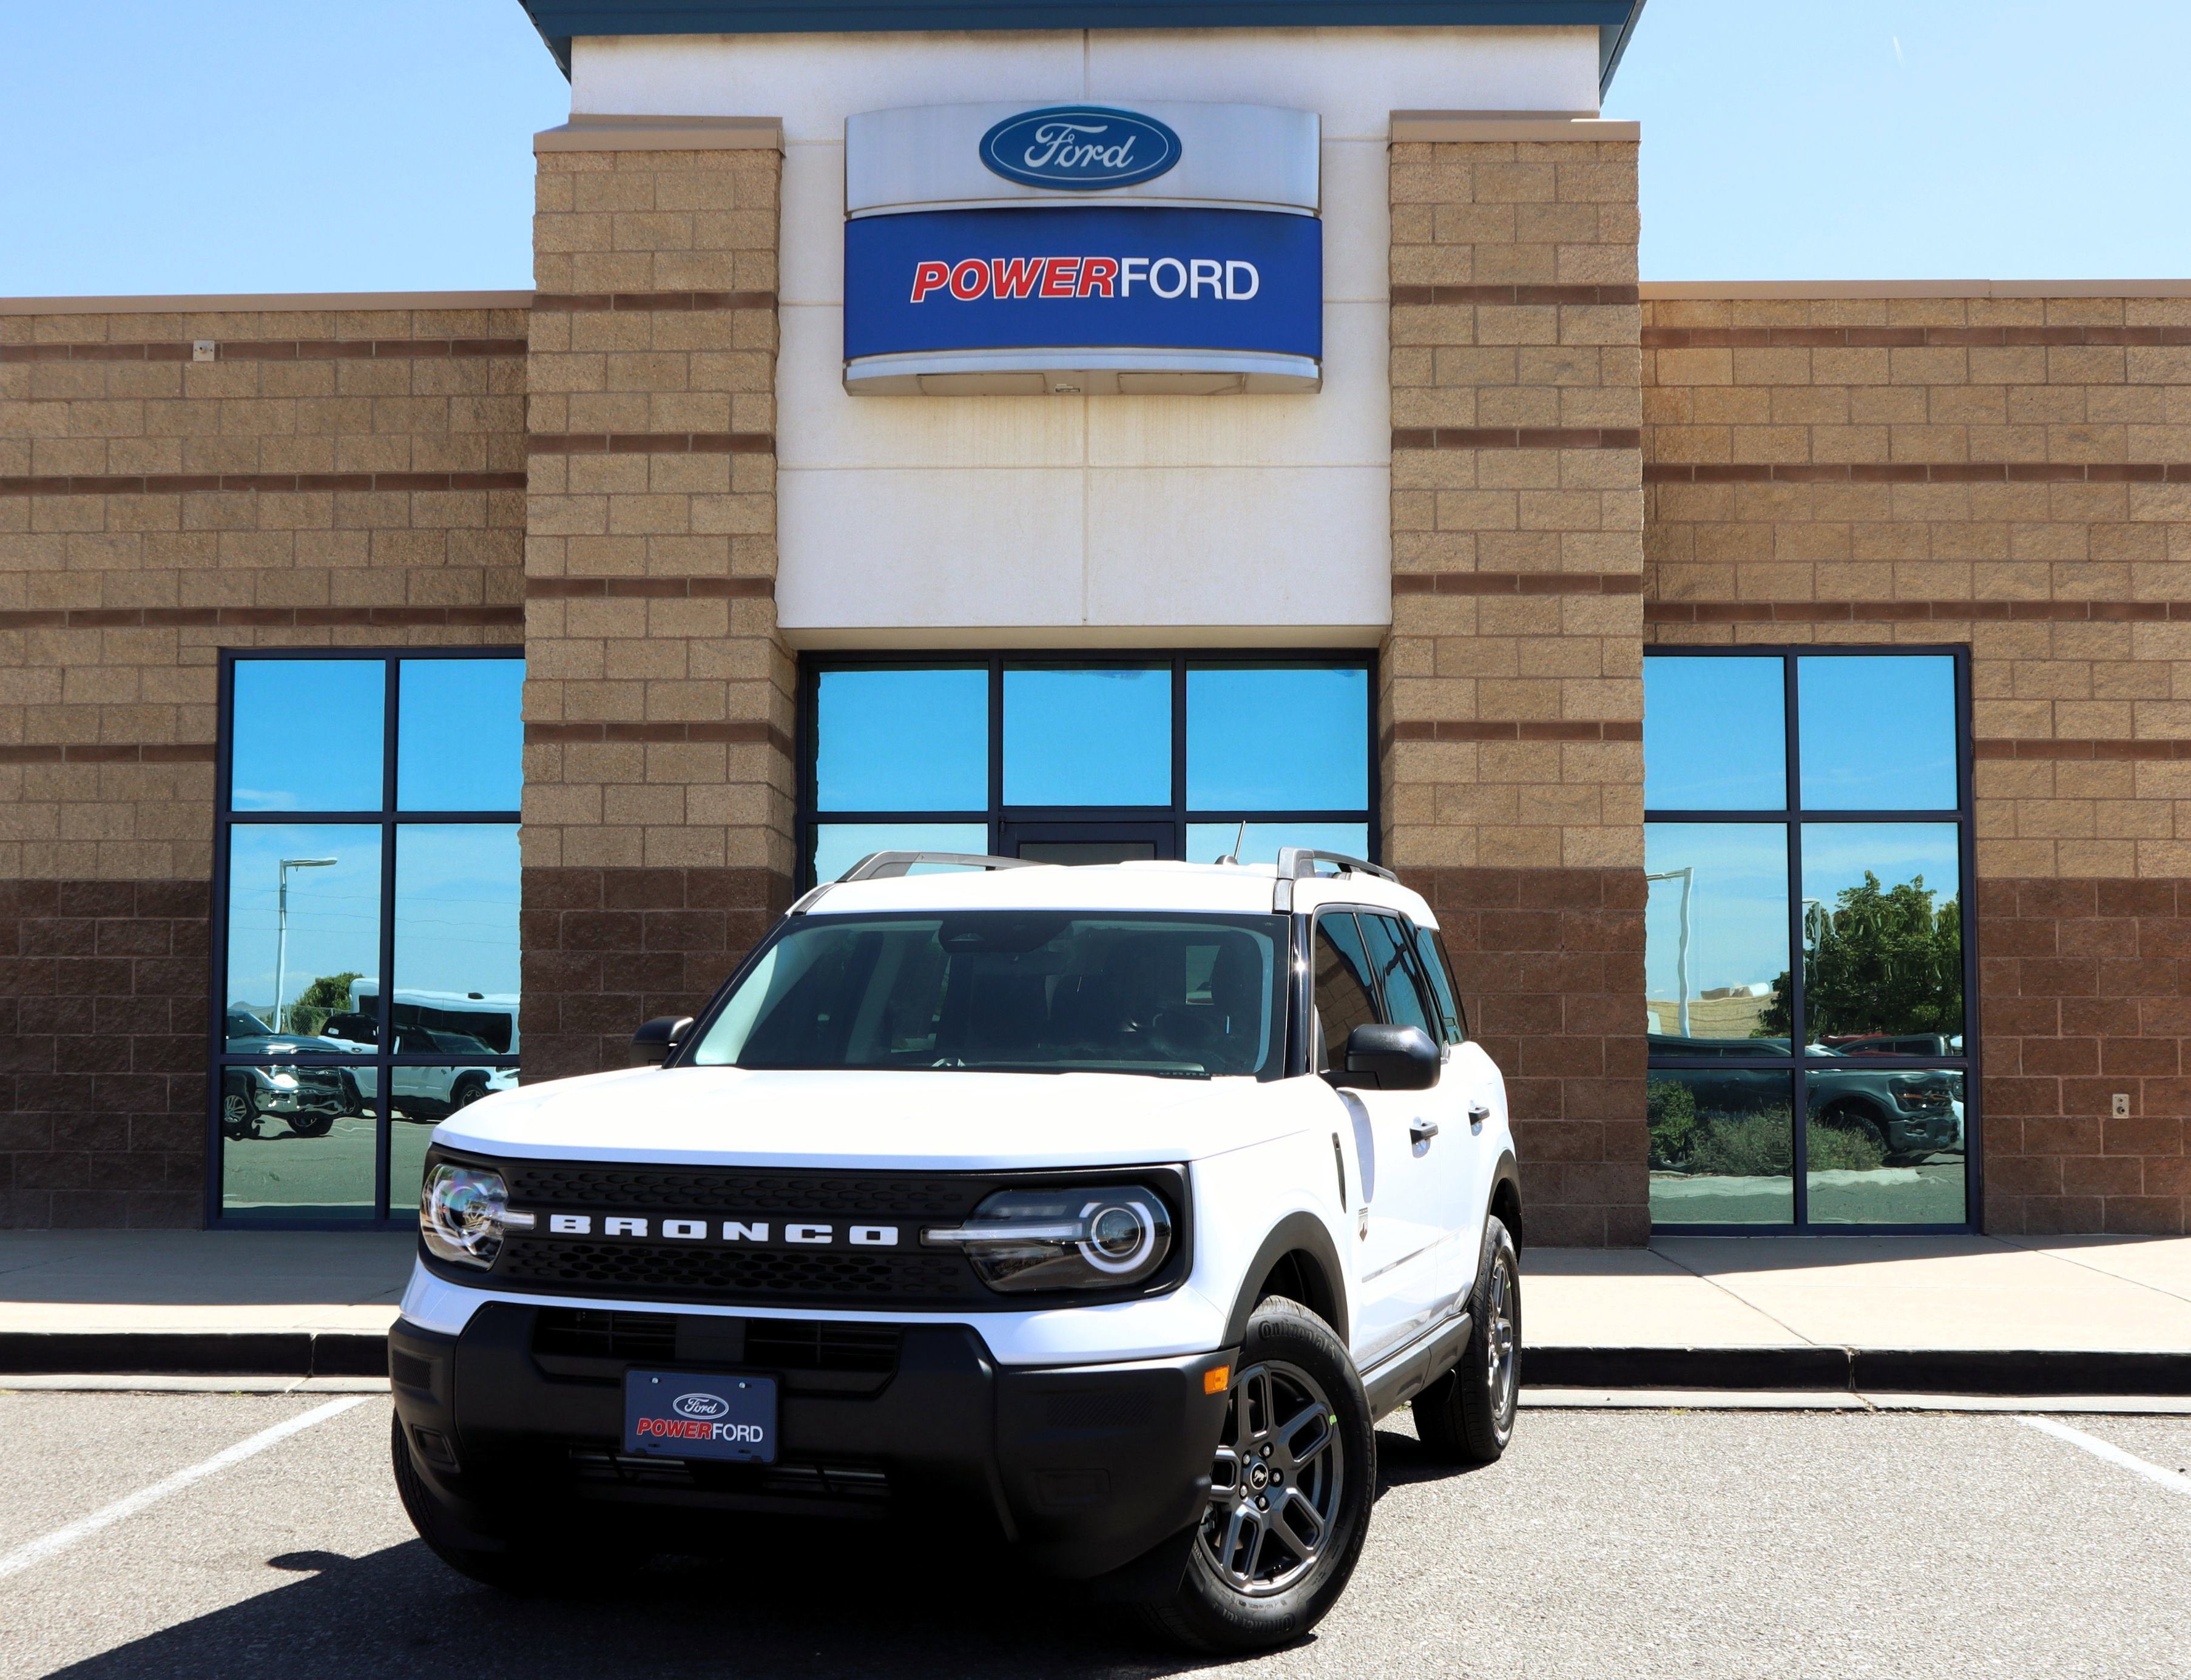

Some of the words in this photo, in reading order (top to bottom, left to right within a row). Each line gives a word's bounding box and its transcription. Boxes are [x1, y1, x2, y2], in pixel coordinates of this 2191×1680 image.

[1024, 122, 1137, 169] Ford
[910, 256, 1260, 304] POWERFORD
[549, 1213, 899, 1246] BRONCO
[1258, 1318, 1329, 1354] Continental
[684, 1397, 718, 1414] Ford
[636, 1417, 764, 1443] POWERFORD
